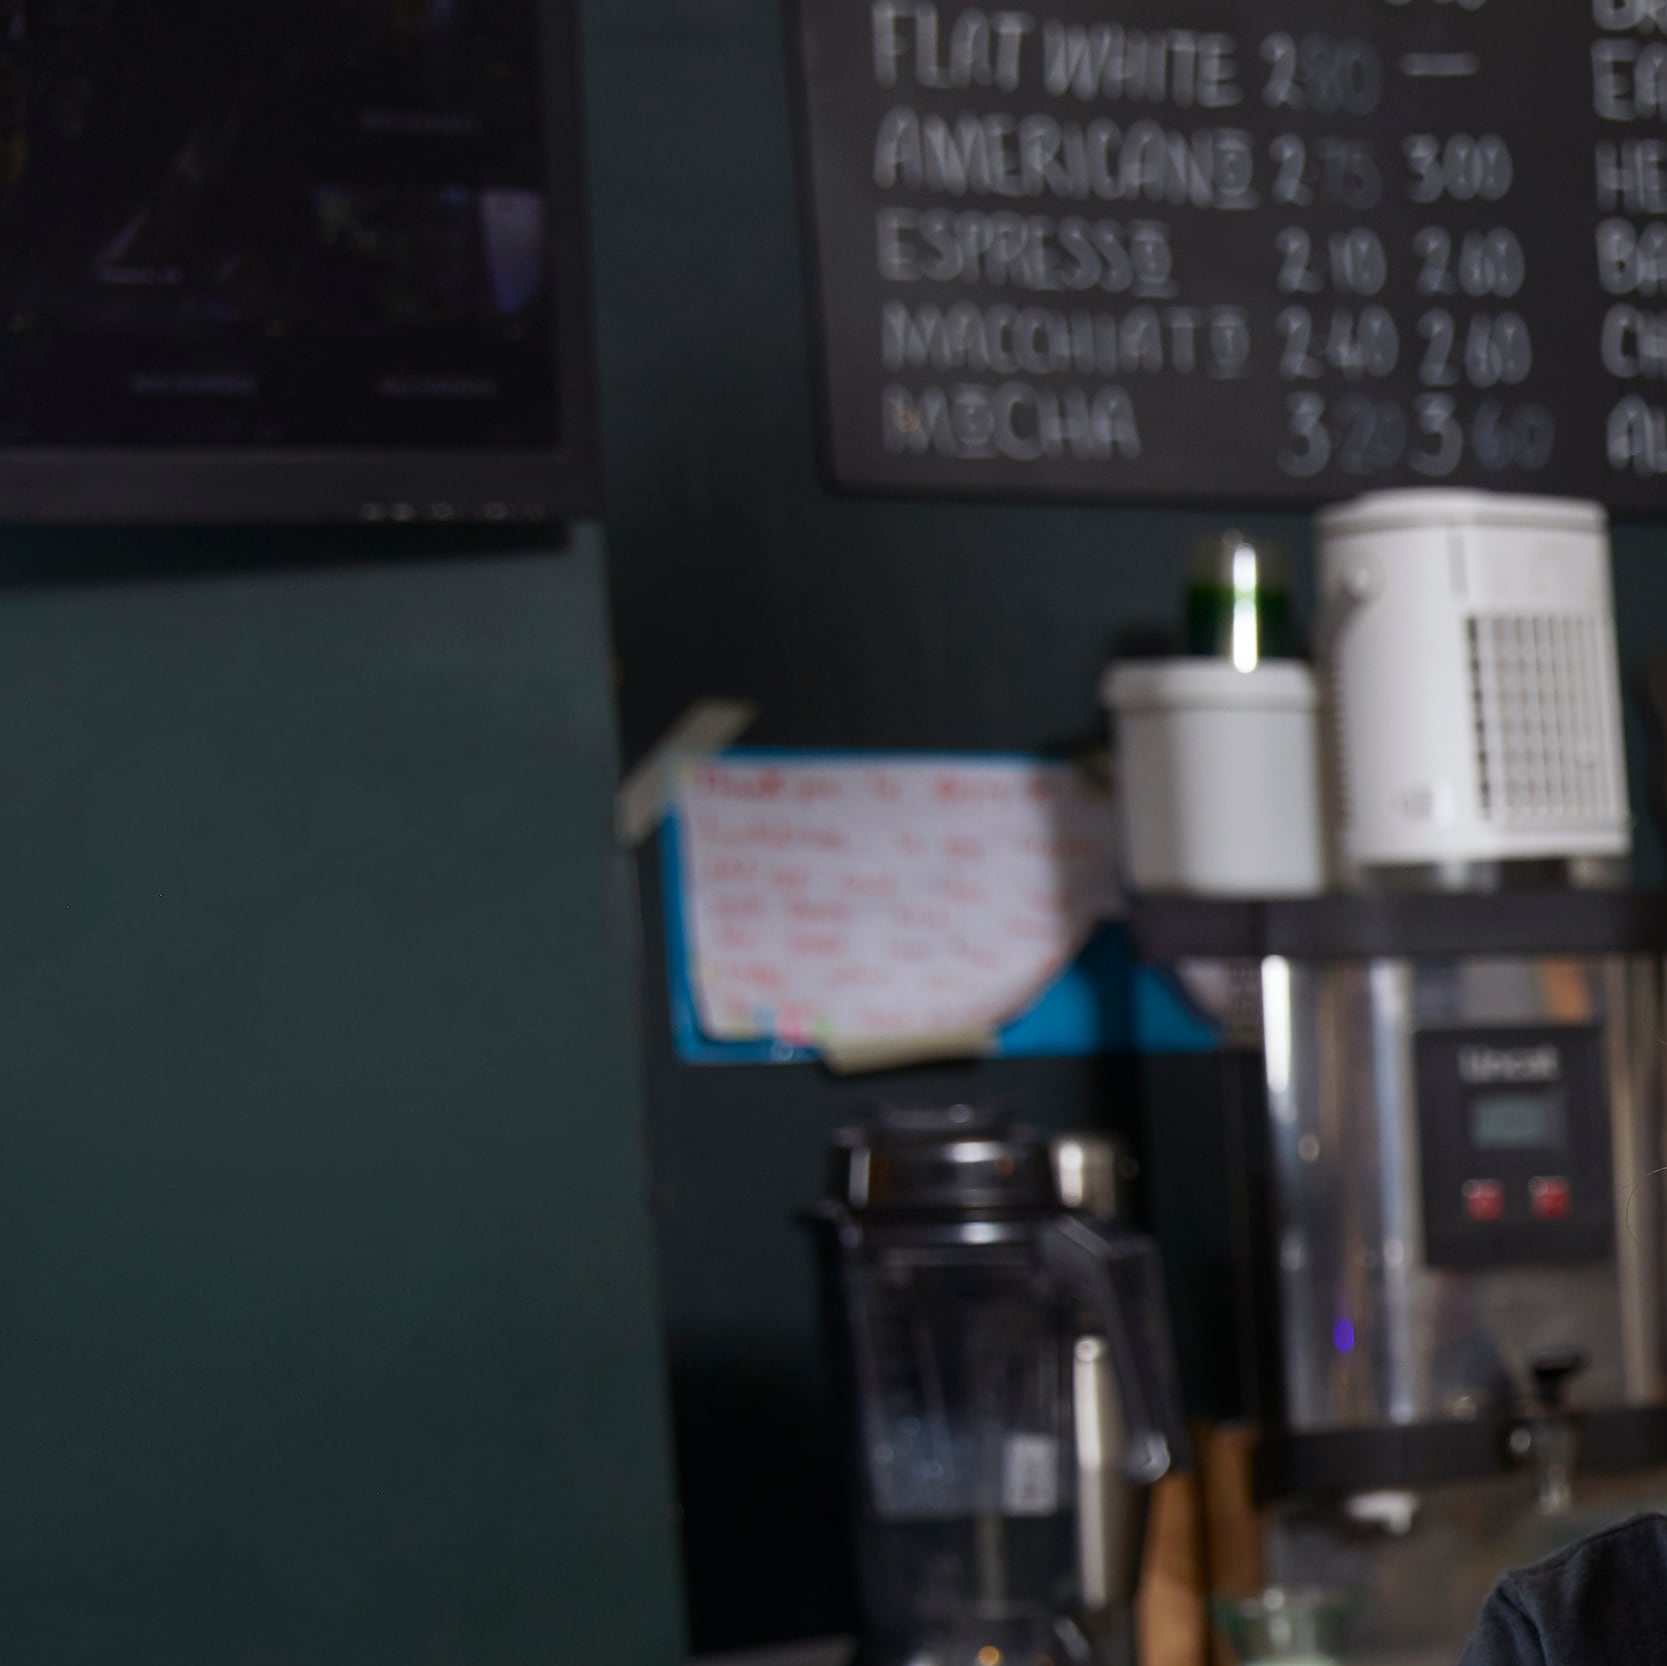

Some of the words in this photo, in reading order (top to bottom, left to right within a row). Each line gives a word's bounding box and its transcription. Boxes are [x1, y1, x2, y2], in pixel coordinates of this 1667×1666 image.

[870, 0, 1037, 93] FLAT
[1041, 18, 1242, 109] WHITE
[872, 104, 1262, 210] AMERICANO
[874, 207, 1179, 299] ESPRESSO
[879, 299, 1251, 381] MACCHIATO
[879, 380, 1142, 462] MOCHA
